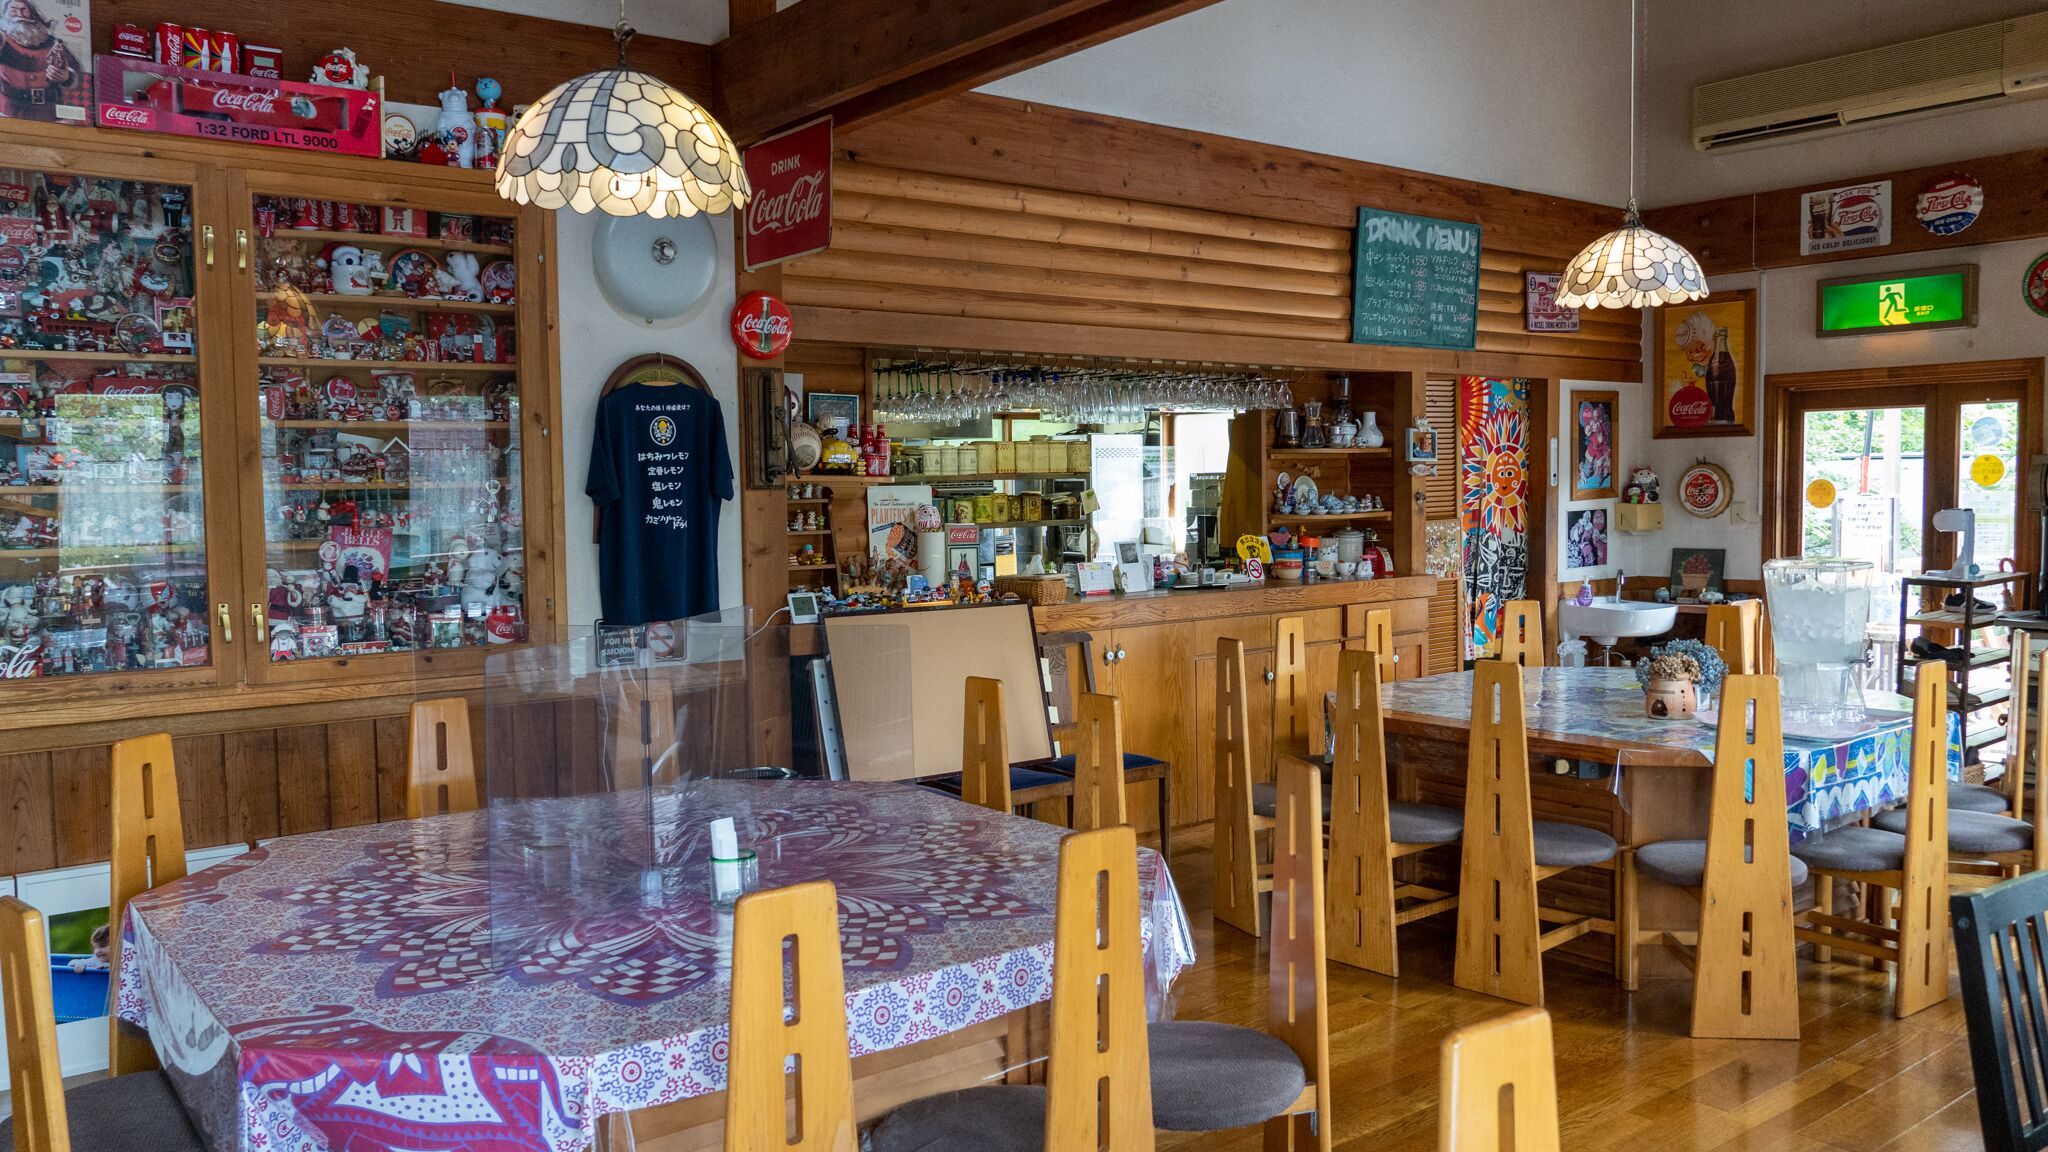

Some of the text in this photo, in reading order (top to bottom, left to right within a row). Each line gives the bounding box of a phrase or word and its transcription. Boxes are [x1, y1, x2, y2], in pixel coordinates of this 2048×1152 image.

[250, 67, 280, 80] Coca-Cola
[212, 88, 275, 114] Coca-Cola
[105, 106, 149, 124] Coca-Cola
[196, 121, 339, 150] 1:32 FORD LTL 9000
[771, 153, 801, 176] DRINK
[1935, 179, 1956, 190] DRINK
[1856, 187, 1871, 197] FOR
[749, 169, 826, 236] Coca-Cola
[1934, 214, 1964, 226] ICE COLD
[1365, 216, 1470, 254] DRINK MENU
[1811, 243, 1821, 251] ICE
[740, 312, 791, 336] Coca-Cola
[270, 389, 280, 418] Coca-Cola
[1672, 401, 1711, 416] Coca-Cola
[638, 451, 690, 462] はちみつレモン
[647, 466, 684, 477] 定番レモン
[651, 481, 682, 492] 塩レモン
[652, 496, 683, 510] 鬼レモン
[871, 507, 907, 524] PLANTERS
[949, 527, 977, 540] Coca-Cola
[344, 535, 380, 546] BELLS
[604, 636, 640, 646] FOR NOT
[601, 646, 638, 656] SMOKIN
